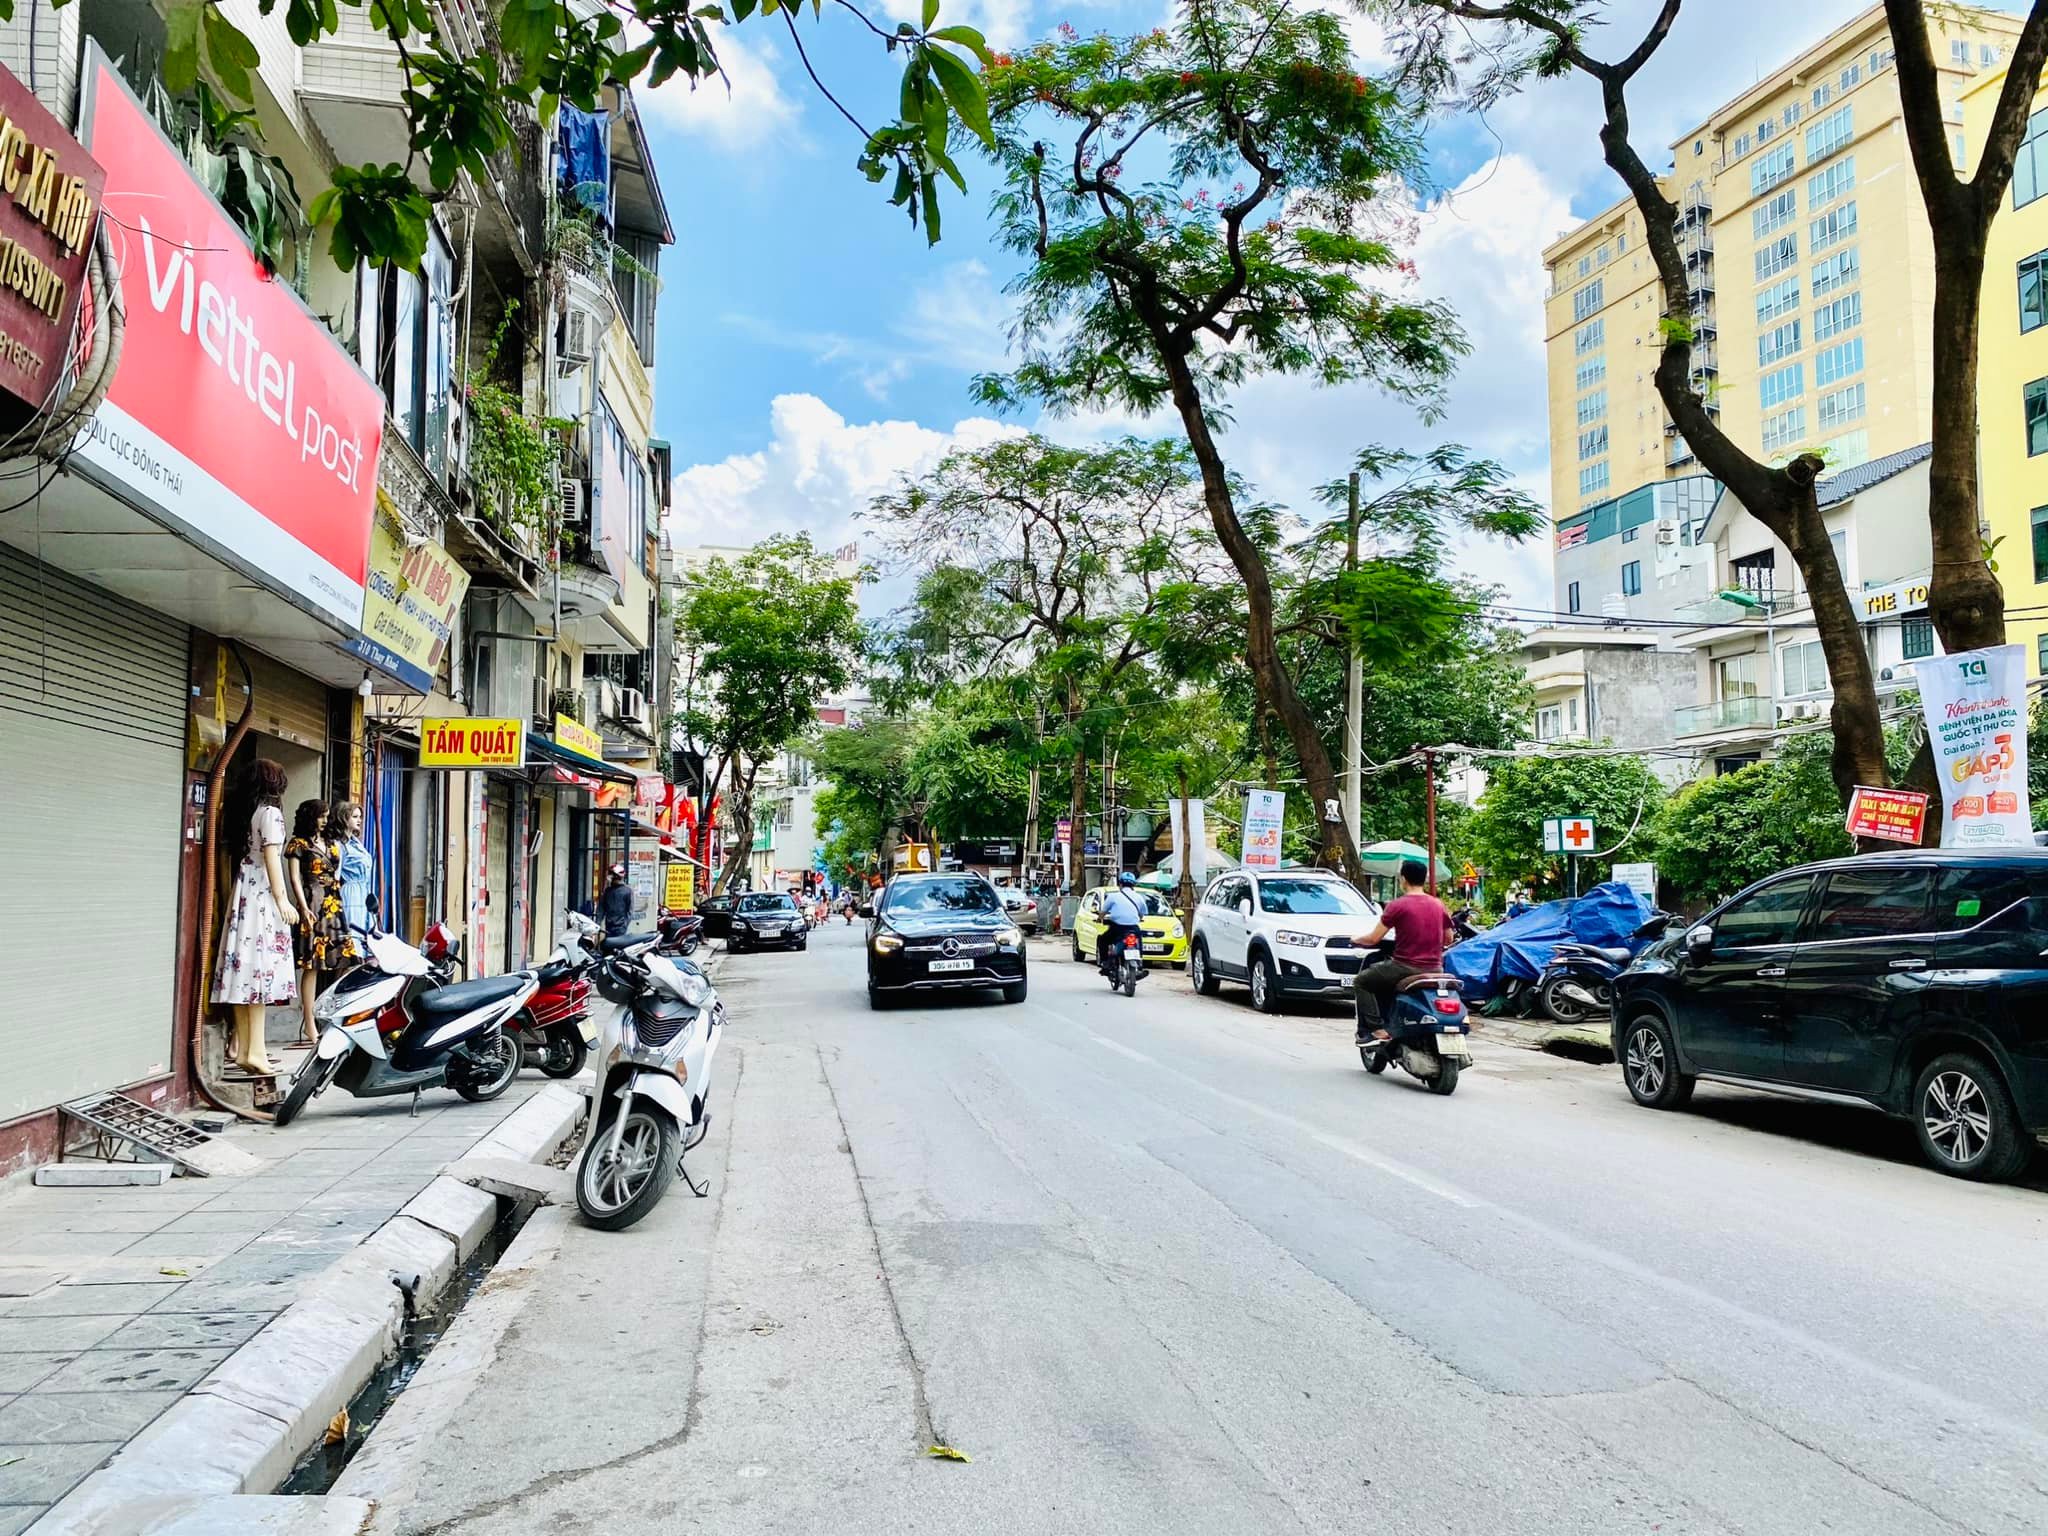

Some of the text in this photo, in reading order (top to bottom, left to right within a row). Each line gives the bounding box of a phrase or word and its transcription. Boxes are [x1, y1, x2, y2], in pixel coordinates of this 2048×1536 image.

[20, 144, 57, 225] XÃ
[52, 175, 92, 259] HỘI
[109, 432, 131, 460] CỤC
[163, 467, 183, 496] THÁI
[302, 406, 363, 494] post
[424, 559, 452, 607] BÉO
[1864, 592, 1897, 616] THE
[1959, 660, 1987, 678] TCI
[426, 720, 517, 757] TẨM QUẤT
[1901, 803, 1922, 816] BAY
